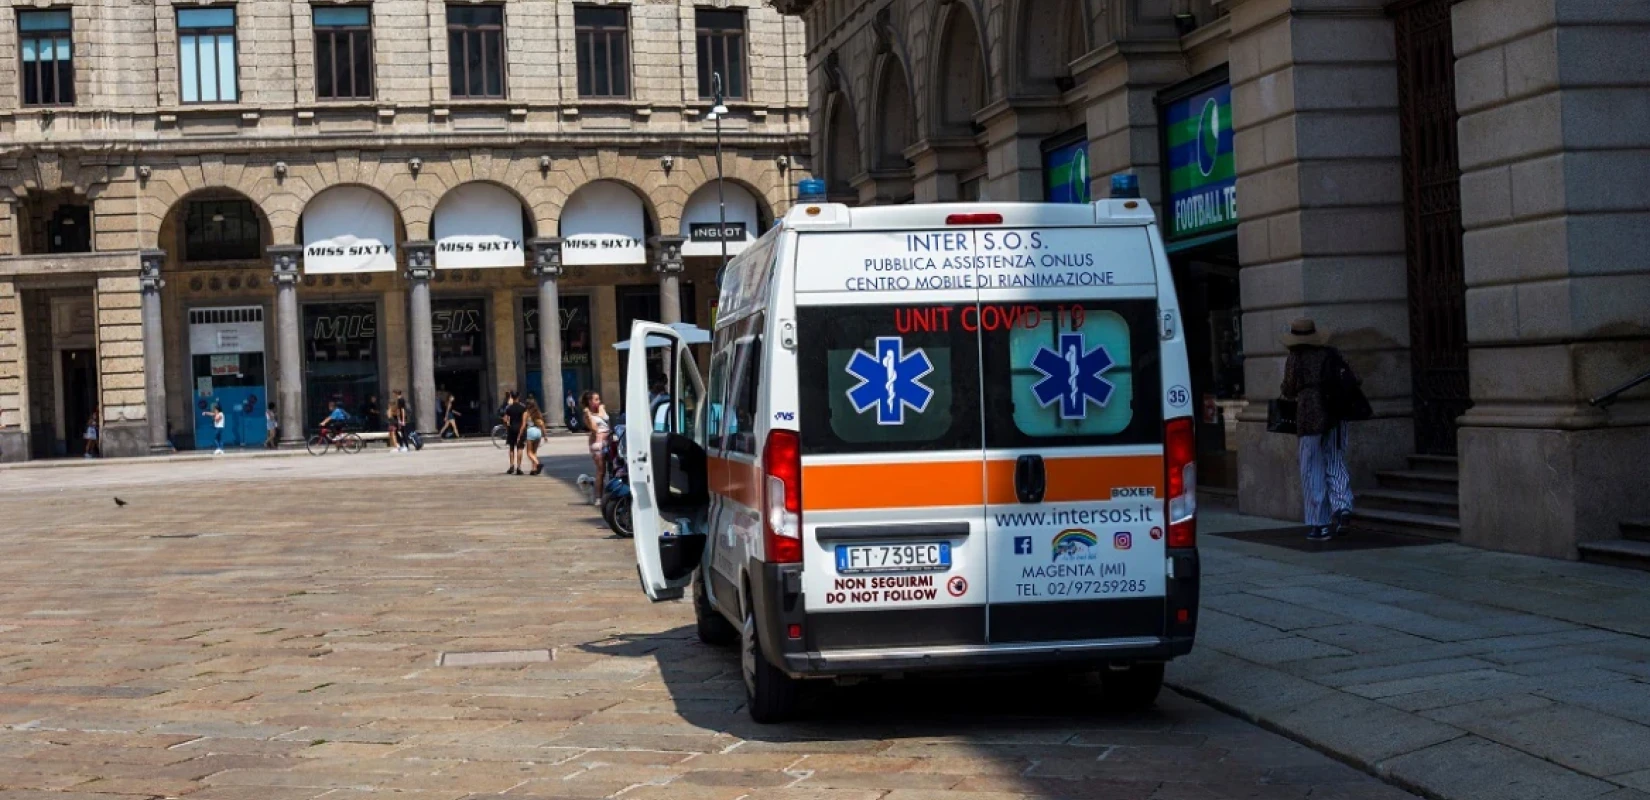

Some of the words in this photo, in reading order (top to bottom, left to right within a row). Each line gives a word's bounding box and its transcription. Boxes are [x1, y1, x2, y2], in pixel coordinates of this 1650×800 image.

[1175, 188, 1222, 231] FOOTBALL
[438, 243, 474, 252] MISS
[478, 240, 521, 251] SIXTY
[564, 239, 597, 248] MISS
[602, 237, 642, 248] SIXTY
[907, 233, 967, 251] INTER
[984, 231, 1049, 250] S.O.S.
[307, 247, 345, 256] MISS
[348, 244, 393, 255] SIXTY
[864, 257, 936, 271] PUBBLICA
[942, 255, 1036, 270] ASSISTENZA
[1041, 254, 1094, 267] ONLUS
[846, 276, 910, 291] CENTRO
[915, 275, 972, 289] MOBILE
[978, 275, 994, 287] DI
[999, 271, 1114, 287] RIANIMAZIONE
[894, 307, 953, 333] UNIT
[960, 304, 1085, 331] COVID-19
[1169, 390, 1186, 403] 35
[1111, 487, 1155, 498] BOXER
[995, 505, 1154, 528] www.intersos.it
[1022, 564, 1095, 578] MAGENTA
[1100, 562, 1126, 577] (MI)
[835, 578, 866, 590] NON
[871, 575, 933, 588] SEGUIRMI
[1016, 583, 1042, 596] TEL.
[1048, 580, 1147, 595] 02/97259285
[826, 593, 846, 604] DO
[851, 591, 879, 603] NOT
[883, 588, 938, 601] FOLLOW
